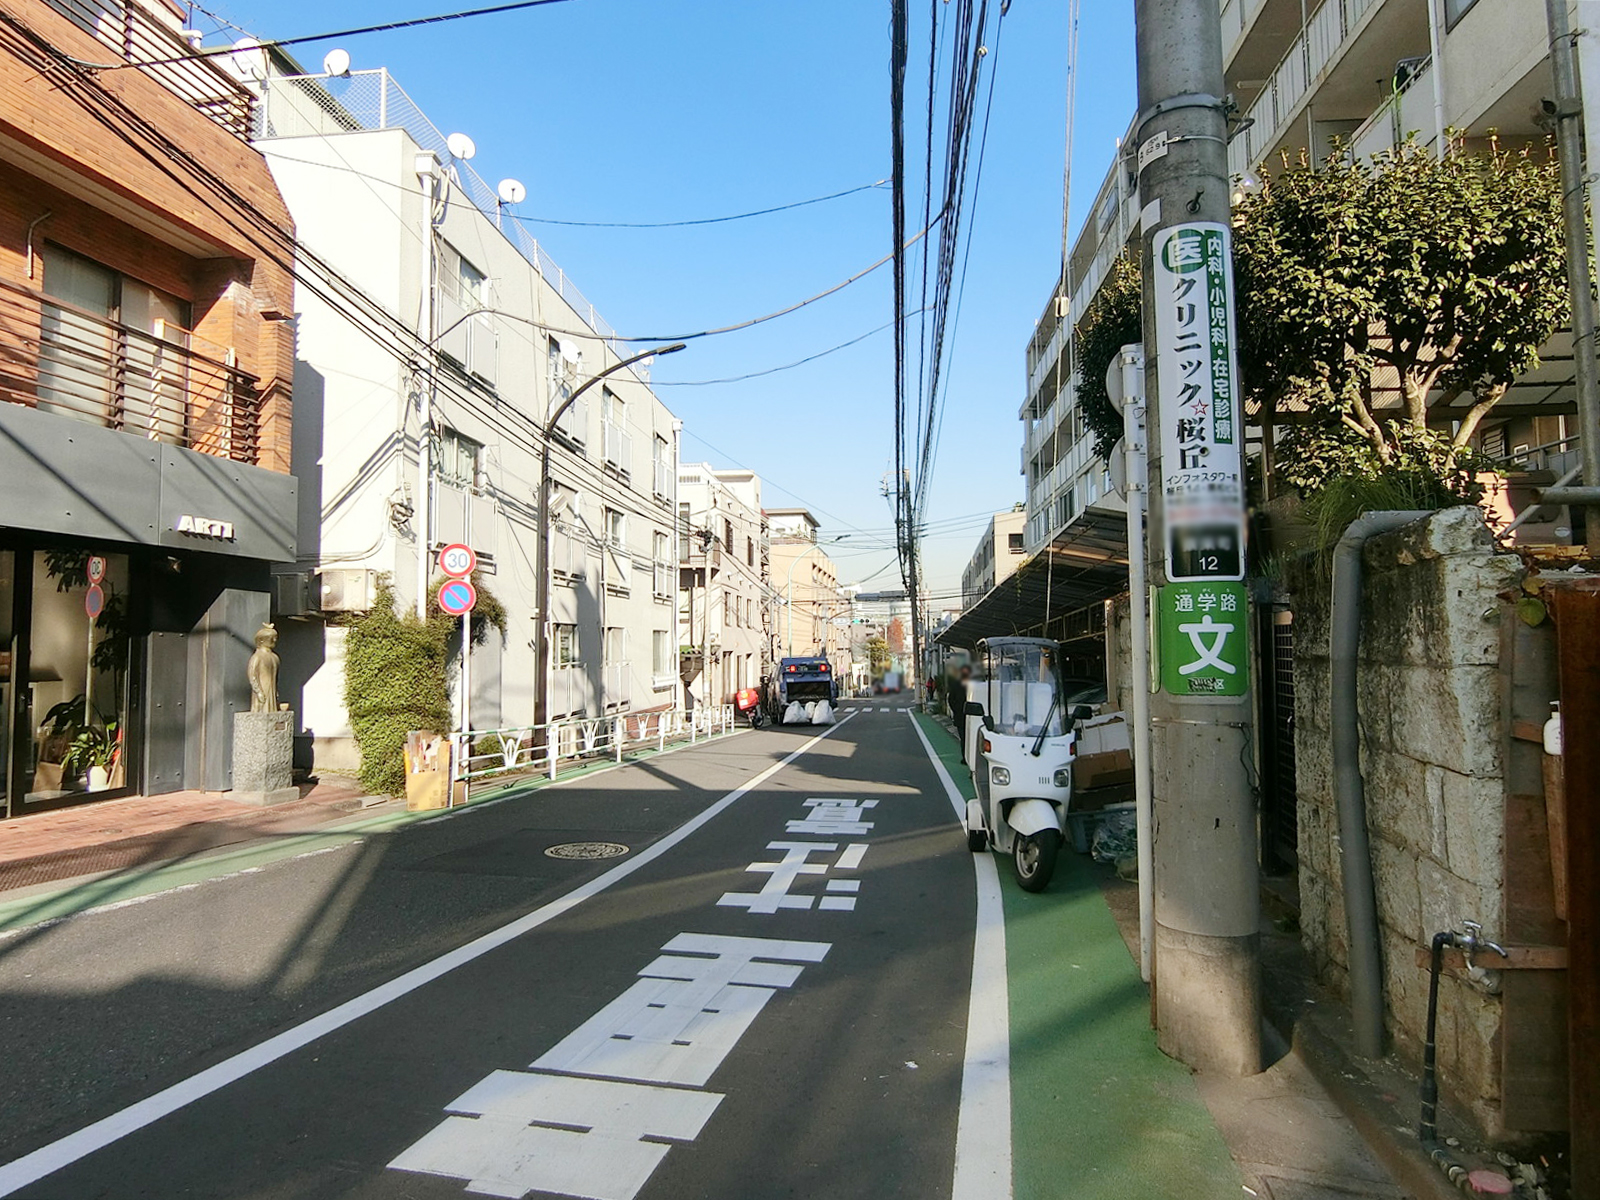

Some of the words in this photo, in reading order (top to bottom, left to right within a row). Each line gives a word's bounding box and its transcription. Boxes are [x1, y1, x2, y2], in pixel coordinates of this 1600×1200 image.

[1167, 235, 1203, 269] 医
[1166, 472, 1238, 485] インフォスタワー
[448, 553, 468, 568] 30
[1199, 556, 1219, 571] 12
[1174, 593, 1237, 612] 通学路
[1178, 614, 1237, 676] 文
